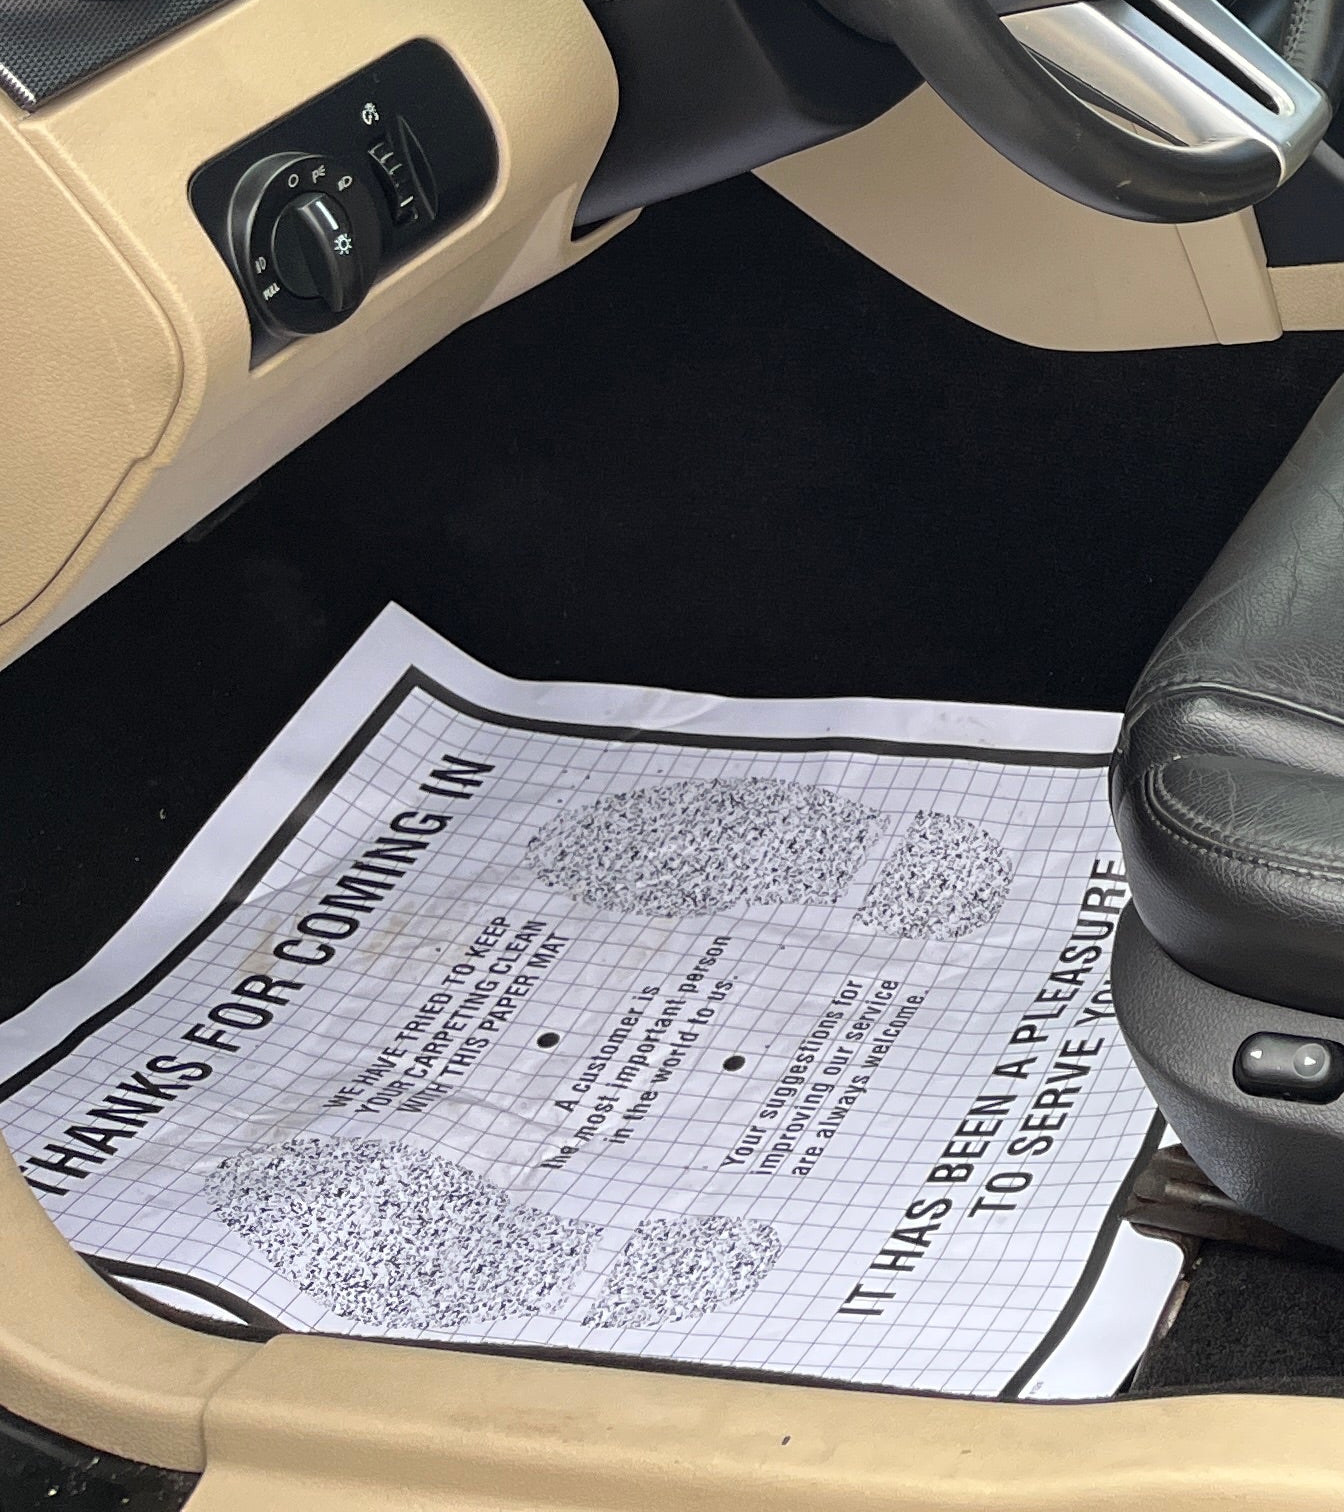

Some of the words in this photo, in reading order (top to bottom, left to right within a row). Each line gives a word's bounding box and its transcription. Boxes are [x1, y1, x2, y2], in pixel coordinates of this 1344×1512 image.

[180, 974, 305, 1052] FOR
[273, 811, 453, 966] COMING
[419, 754, 496, 800] IN
[1008, 859, 1129, 1045] PLEASURE
[322, 1086, 365, 1109] WE
[352, 1047, 407, 1085] HAVE
[395, 993, 453, 1043] TRIED
[442, 963, 475, 986] TO
[465, 916, 511, 958] KEEP
[355, 1080, 415, 1114] YOUR
[404, 980, 499, 1079] CARPETING
[489, 920, 547, 975] CLEAN
[397, 1083, 453, 1113] WITH
[440, 1037, 490, 1076] THIS
[479, 975, 539, 1032] PAPER
[527, 932, 569, 969] MAT
[554, 1099, 579, 1113] A
[572, 1007, 644, 1093] customer
[632, 986, 660, 1002] is
[574, 1095, 619, 1141] most
[605, 998, 686, 1090] important
[678, 937, 731, 994] person
[603, 1128, 634, 1144] in
[622, 1090, 658, 1120] the
[650, 1031, 699, 1085] world
[687, 1008, 714, 1025] to
[707, 976, 738, 1002] us.
[720, 1125, 767, 1167] Your
[760, 1010, 844, 1119] suggestions
[832, 980, 863, 1006] for
[751, 1082, 835, 1175] improving
[823, 1047, 854, 1076] our
[846, 980, 898, 1040] service
[792, 1146, 824, 1176] are
[816, 1075, 870, 1139] always
[861, 989, 929, 1068] welcome.
[992, 1056, 1038, 1080] A
[926, 1094, 1018, 1182] BEEN
[967, 1172, 1033, 1218] TO
[1006, 1037, 1105, 1156] SERVE
[837, 1283, 897, 1316] IT
[869, 1197, 953, 1272] HAS
